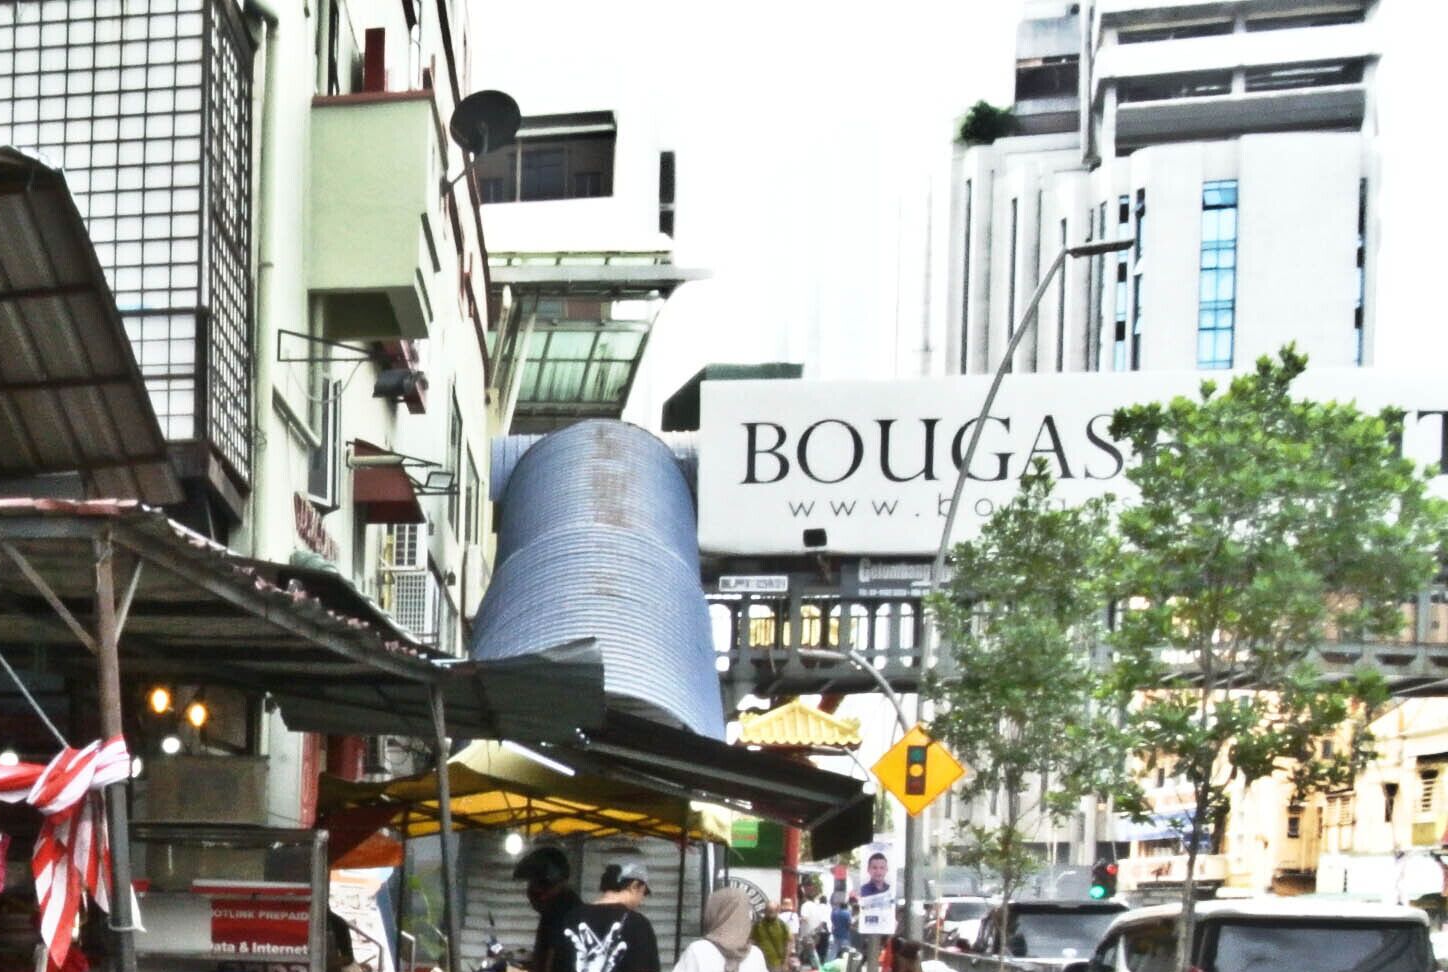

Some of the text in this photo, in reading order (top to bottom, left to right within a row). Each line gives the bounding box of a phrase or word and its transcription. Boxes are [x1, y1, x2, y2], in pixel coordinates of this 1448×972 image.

[211, 910, 309, 921] OTLINK PREPAID
[239, 941, 249, 953] &
[252, 942, 308, 955] Internet
